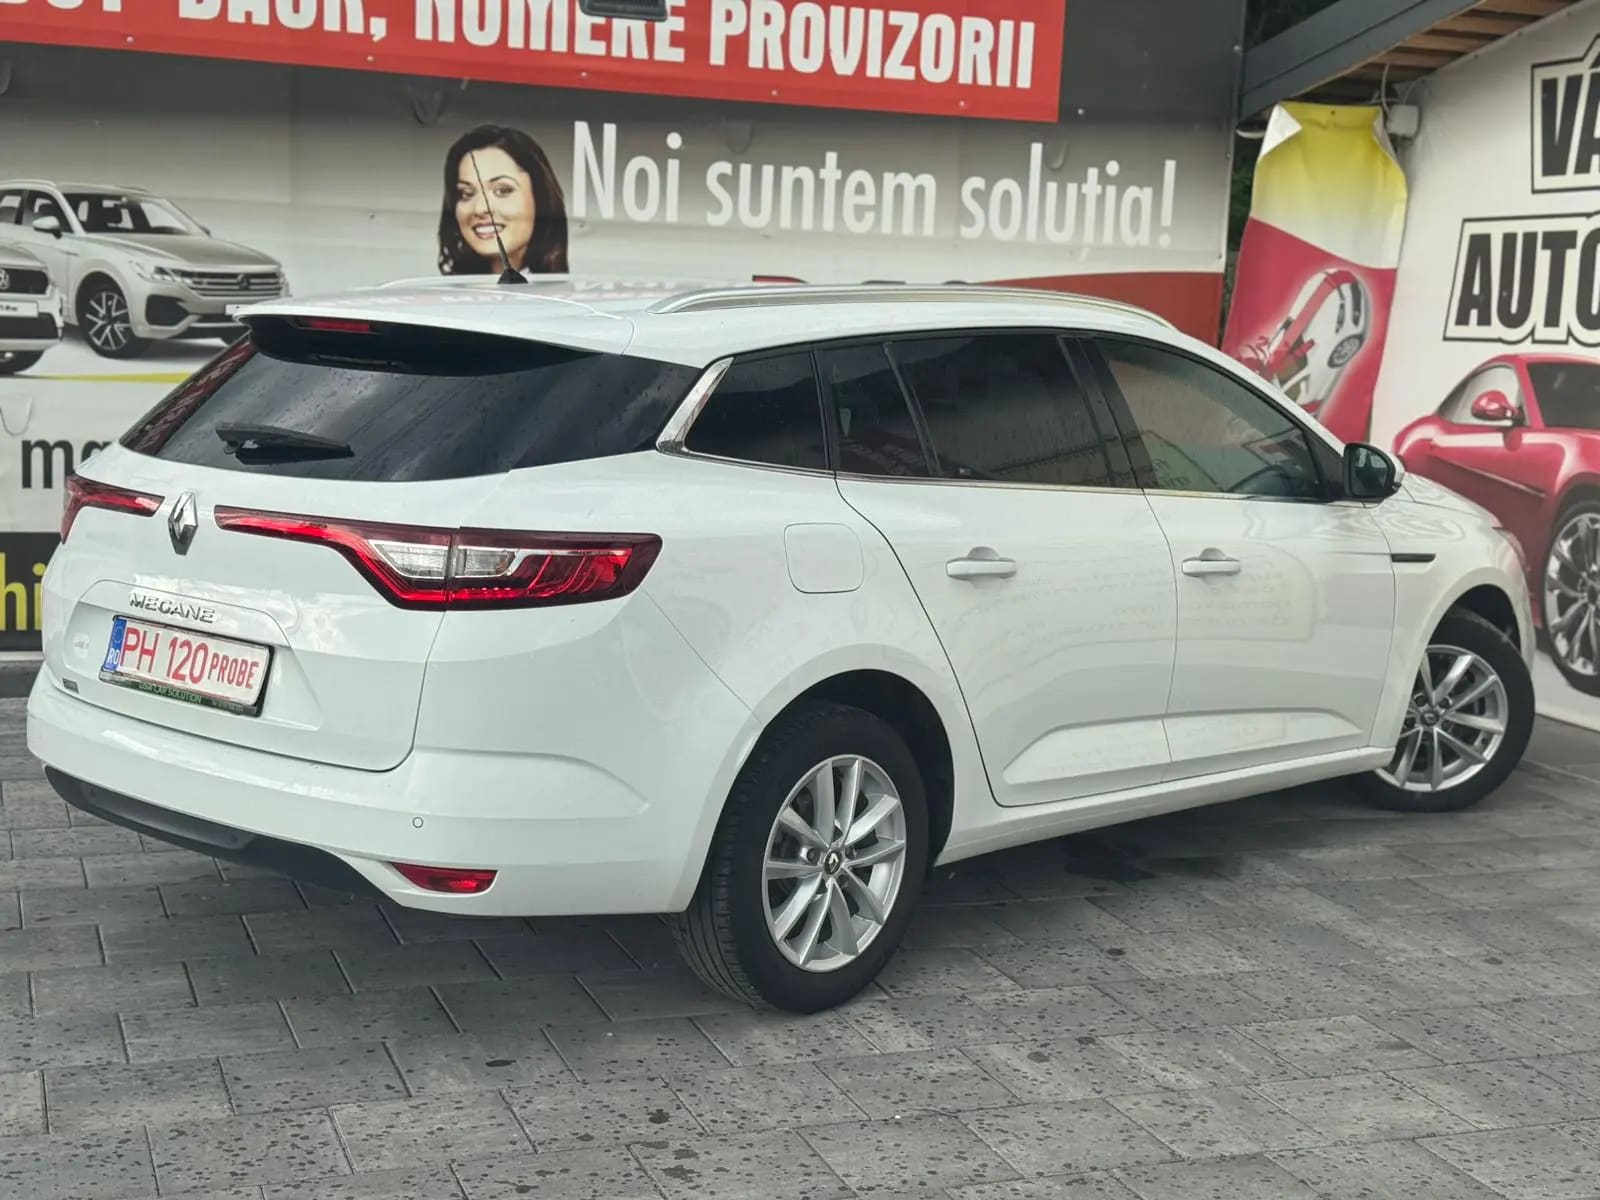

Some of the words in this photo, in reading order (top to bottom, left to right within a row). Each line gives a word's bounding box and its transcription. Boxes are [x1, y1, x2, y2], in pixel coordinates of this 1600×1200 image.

[708, 0, 1035, 89] PROVIZORII
[572, 120, 683, 223] Noi
[706, 151, 938, 237] suntem
[106, 647, 120, 665] RO
[120, 626, 160, 673] PH
[166, 636, 209, 684] 120
[207, 652, 260, 690] PROBE
